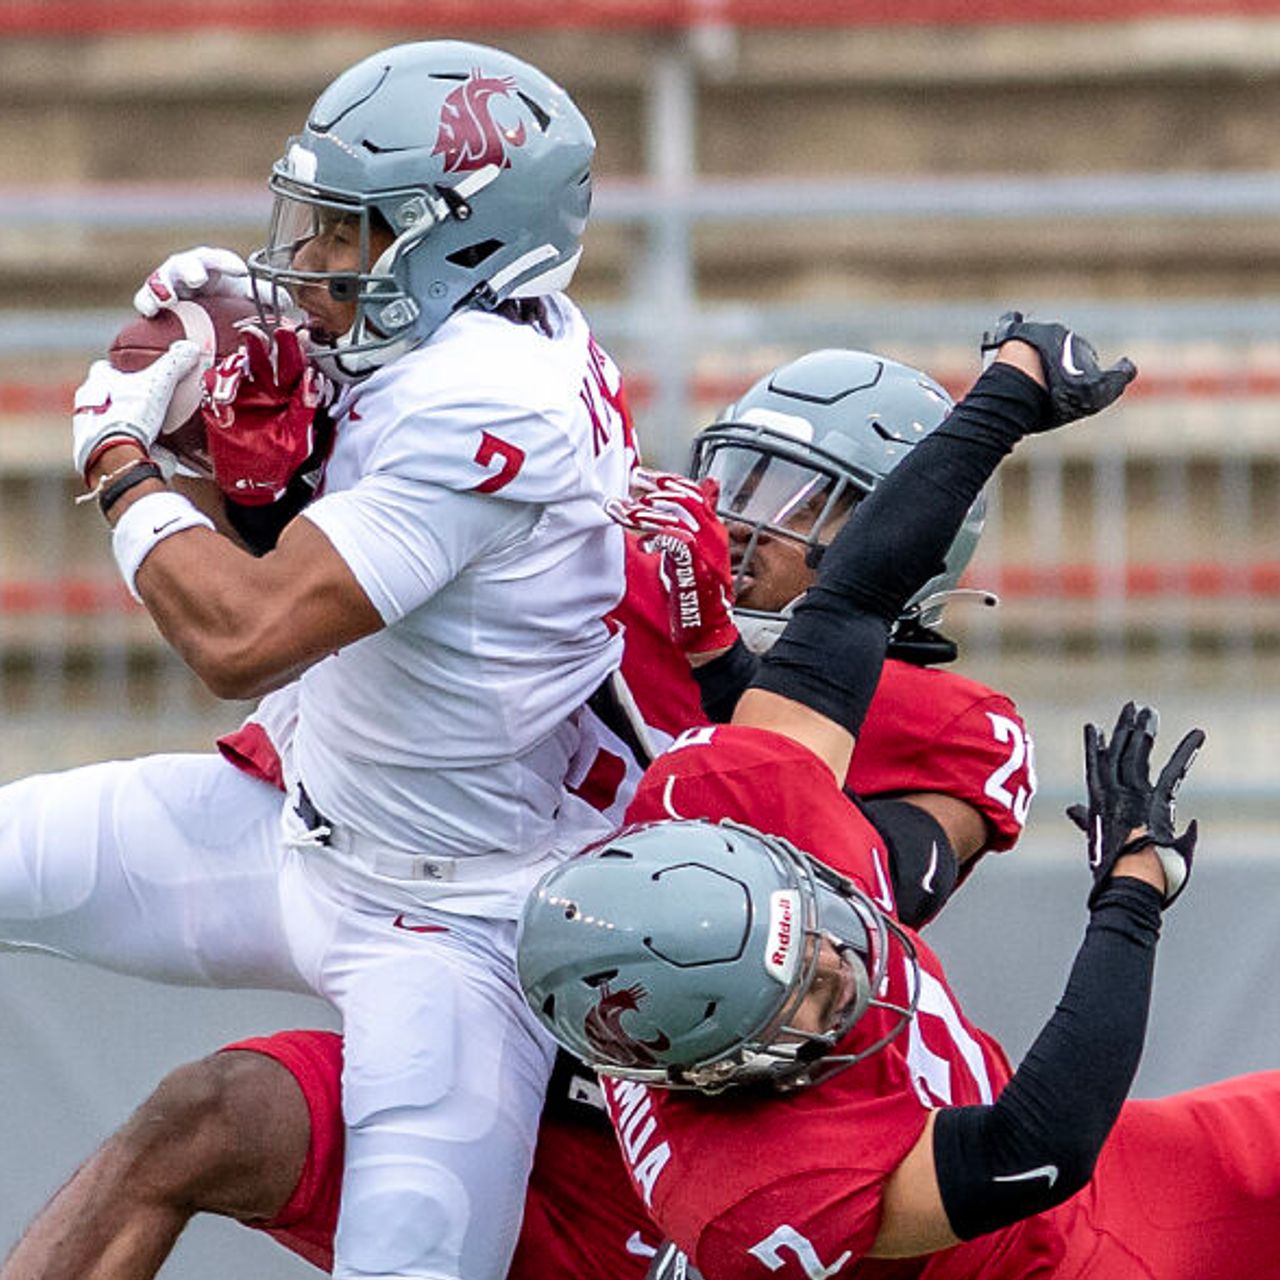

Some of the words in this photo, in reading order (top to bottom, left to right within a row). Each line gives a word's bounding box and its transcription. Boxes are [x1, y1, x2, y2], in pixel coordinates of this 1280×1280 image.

[680, 590, 703, 629] STATE
[771, 898, 792, 967] Riddell
[611, 1076, 672, 1209] MUA
